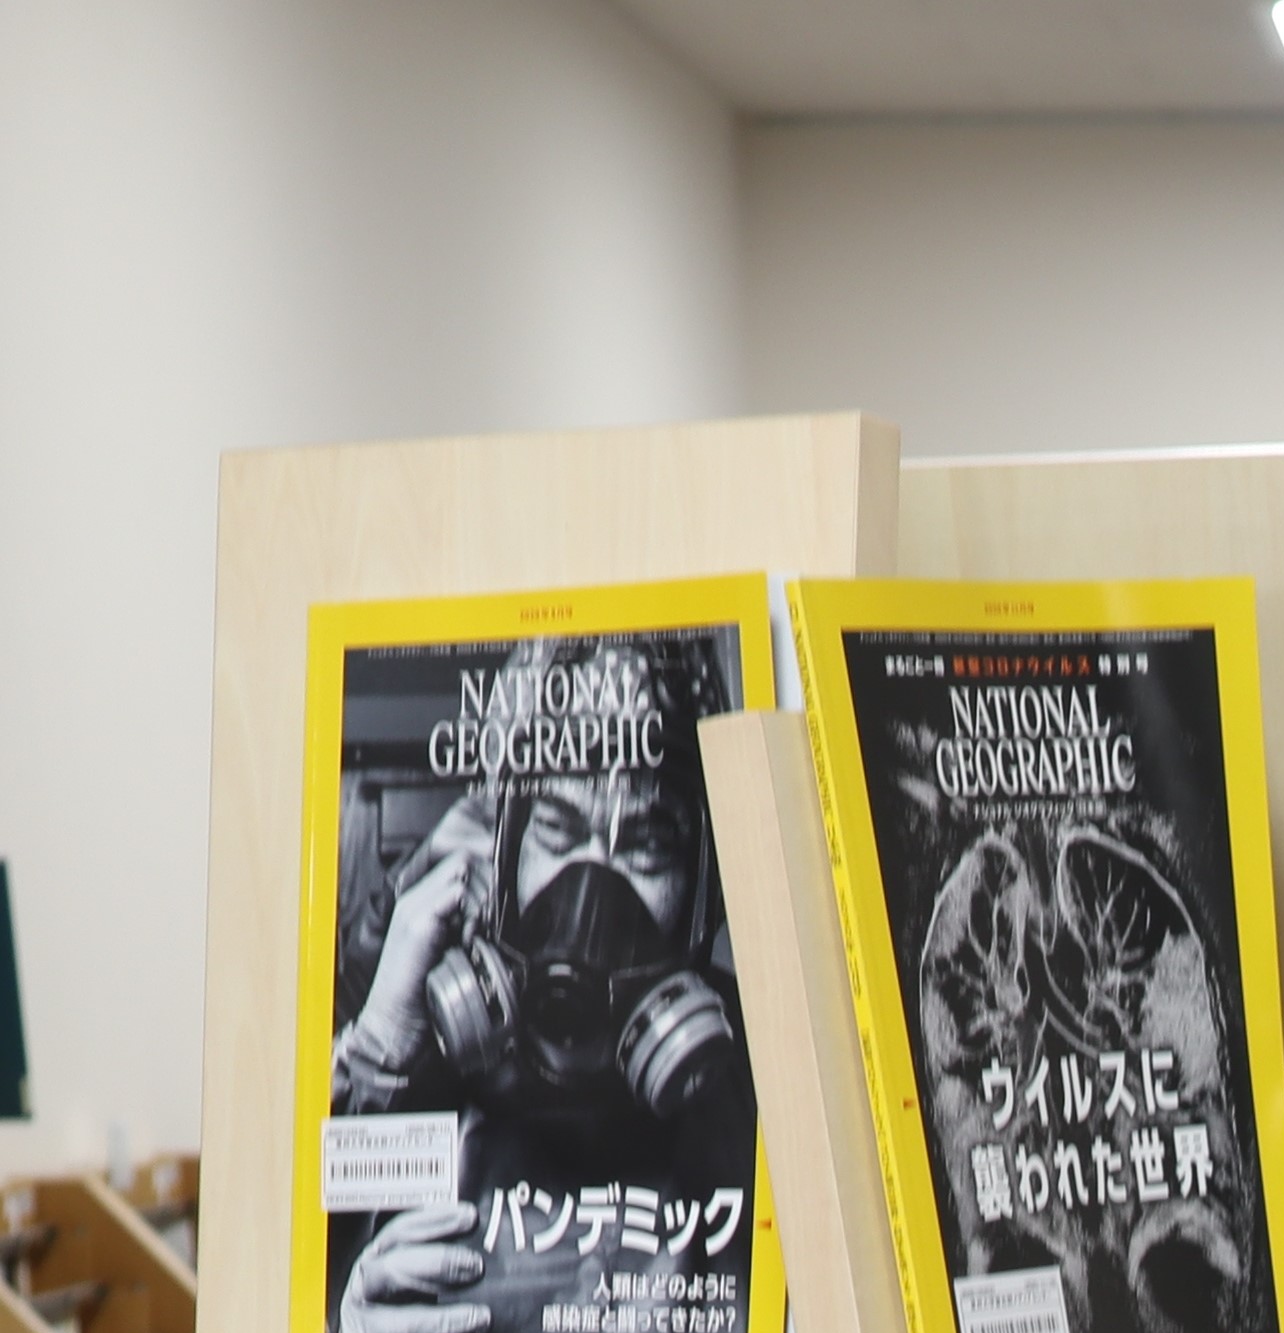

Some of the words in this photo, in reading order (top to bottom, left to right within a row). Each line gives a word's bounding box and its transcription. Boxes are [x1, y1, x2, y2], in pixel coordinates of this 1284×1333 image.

[458, 664, 650, 720] NATIONAL
[949, 684, 1111, 739] NATIONAL
[428, 710, 666, 777] GEOGRAPHIC
[934, 734, 1136, 798] GEOGRAPHIC
[981, 1047, 1179, 1131] ウイルスに
[970, 1122, 1214, 1222] 襲われた世界
[482, 1179, 744, 1258] パンデミック
[592, 1271, 737, 1302] 人類はどのように
